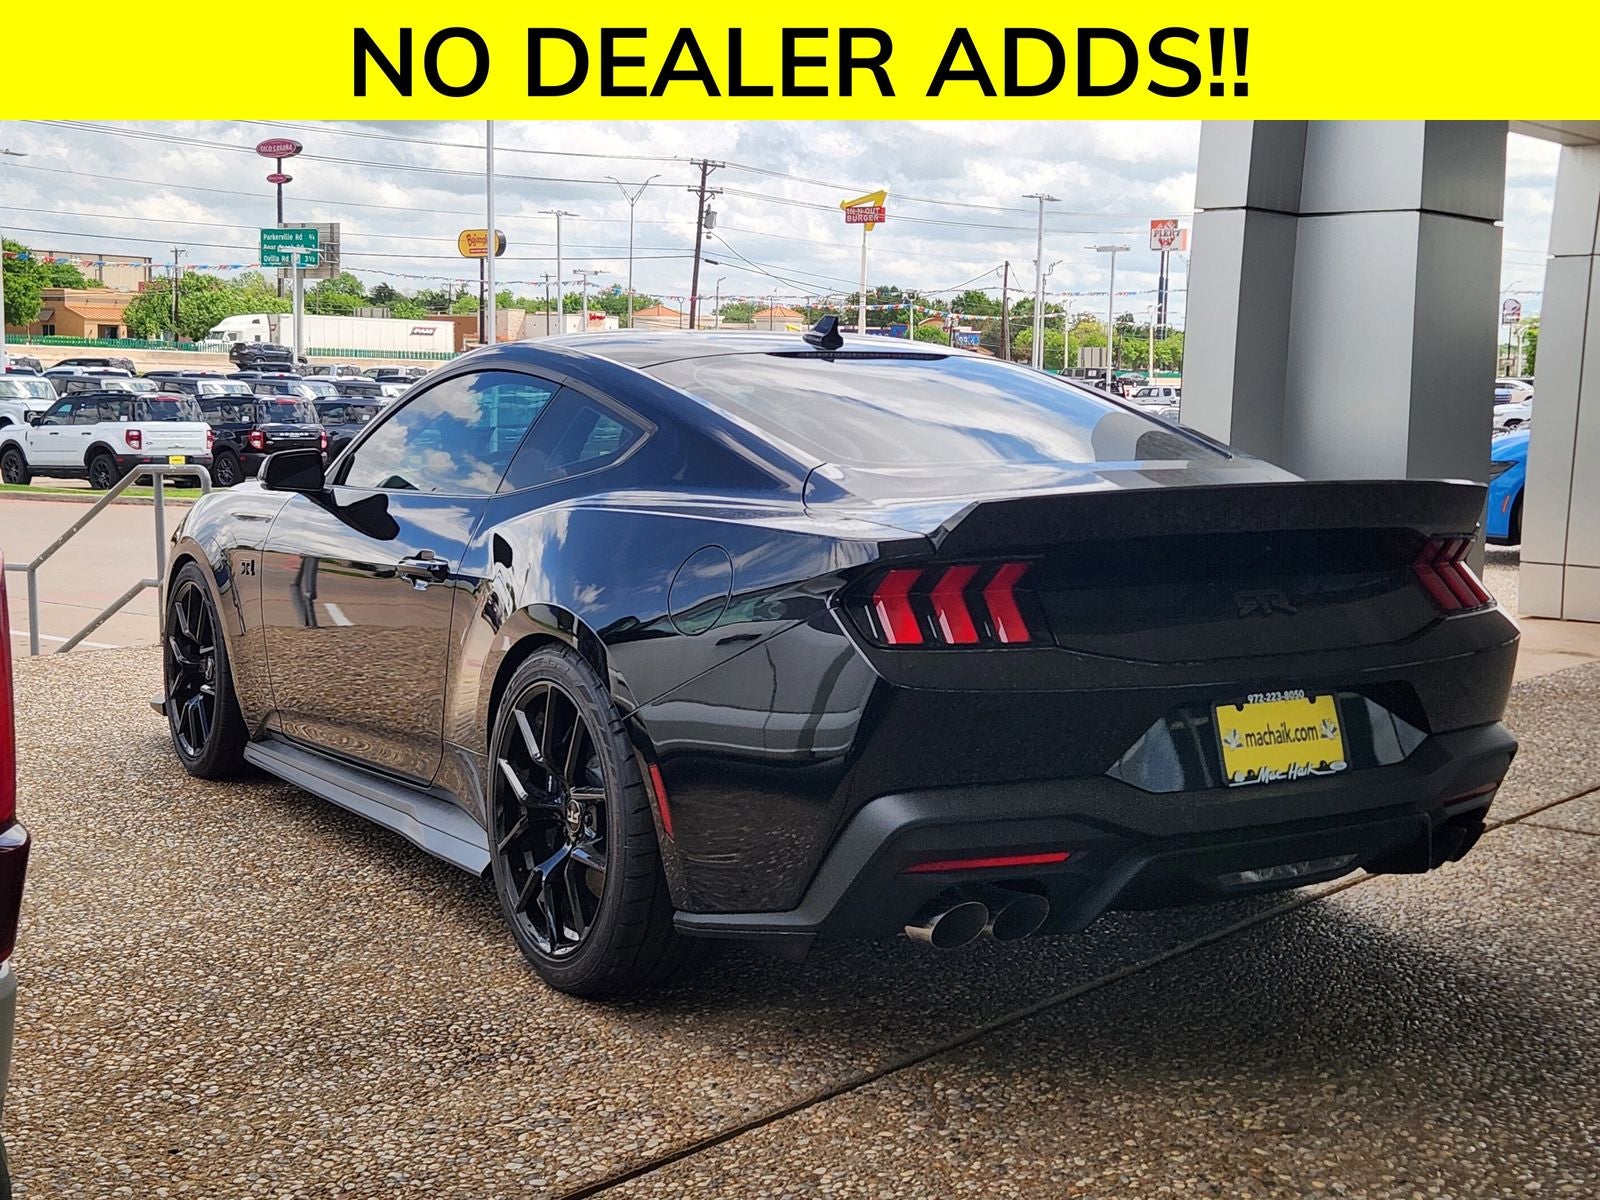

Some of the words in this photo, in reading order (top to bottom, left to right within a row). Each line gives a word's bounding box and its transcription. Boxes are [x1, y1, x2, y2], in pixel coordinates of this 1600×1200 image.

[847, 207, 880, 215] IN-N-OUT
[263, 254, 280, 262] Ovilla
[281, 254, 289, 262] Rd
[1245, 720, 1319, 748] machaik.com
[1258, 766, 1287, 784] Mac
[1288, 761, 1317, 780] Haik
